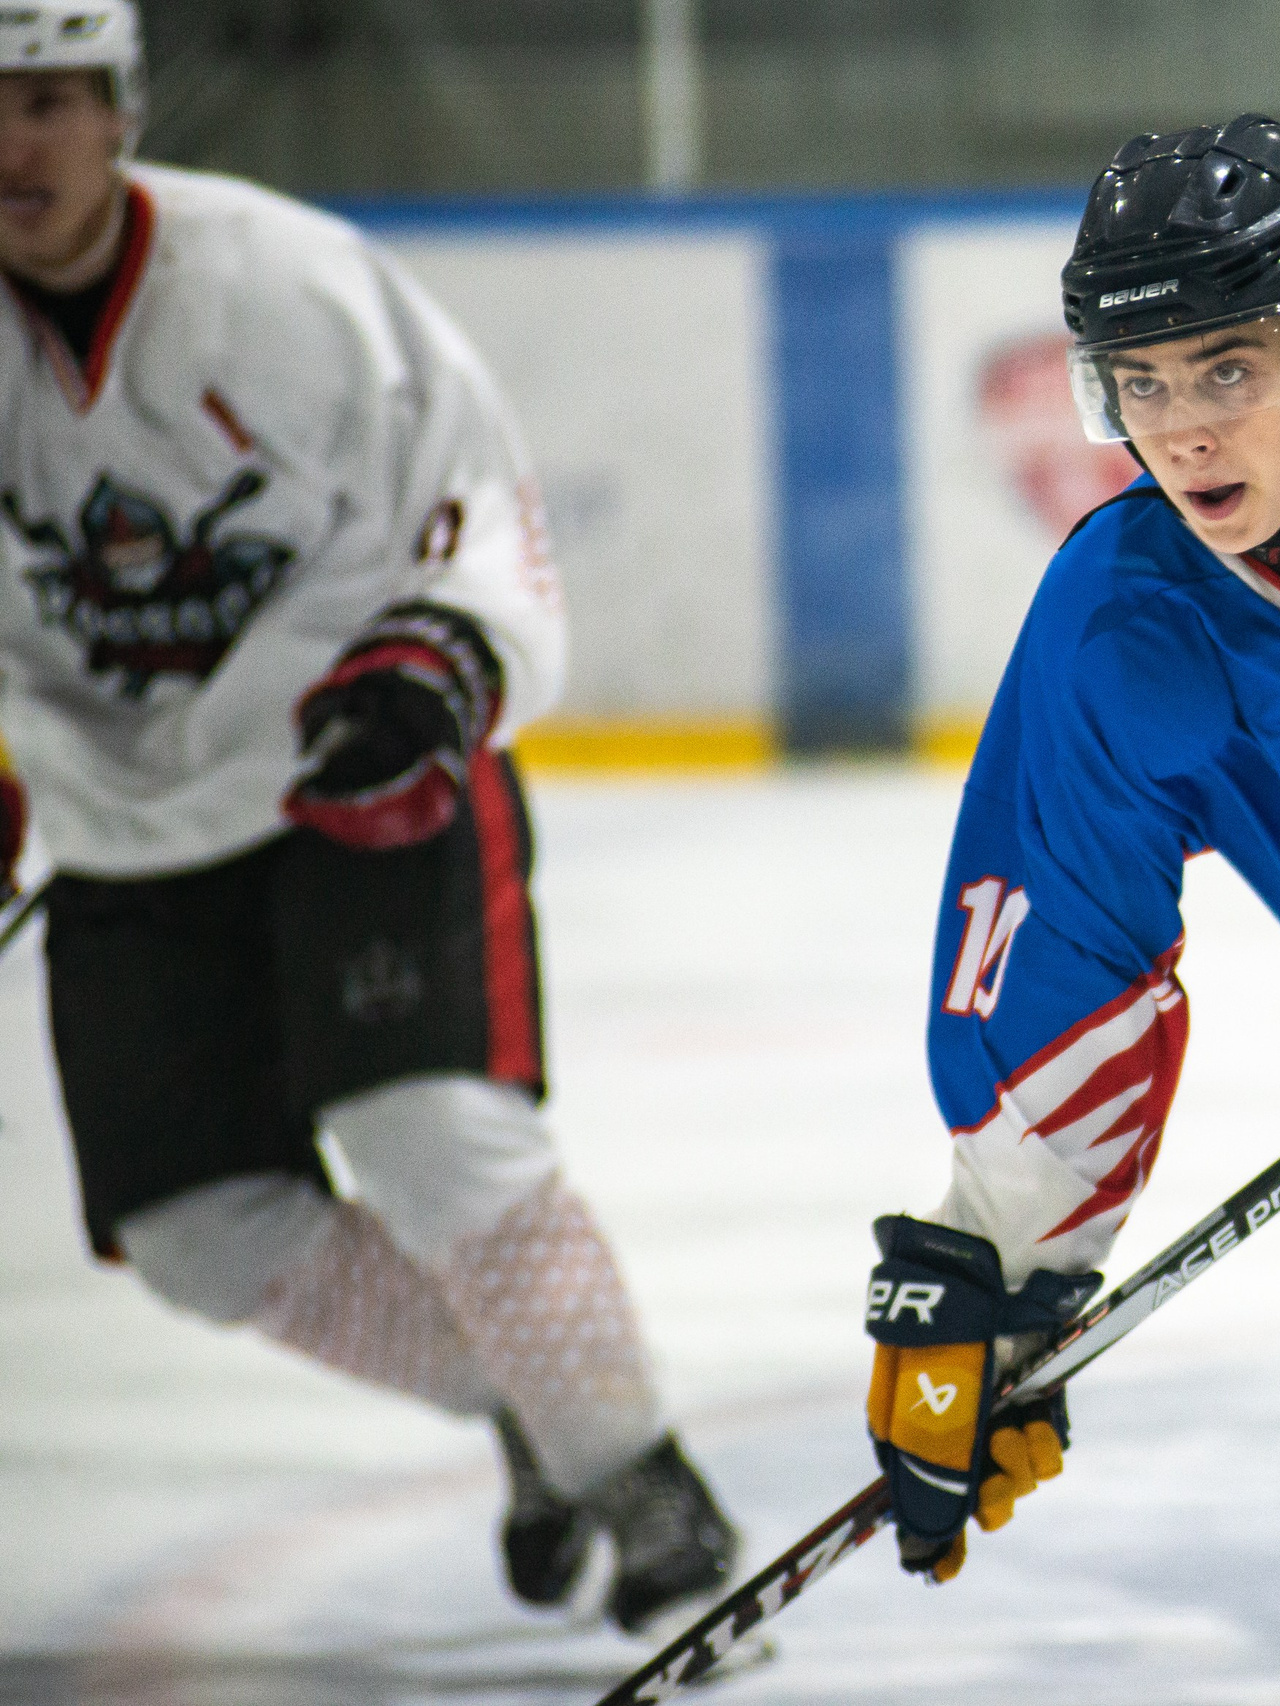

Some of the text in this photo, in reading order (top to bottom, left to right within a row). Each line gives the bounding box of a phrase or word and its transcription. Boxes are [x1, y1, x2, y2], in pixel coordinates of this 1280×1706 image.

[1099, 279, 1179, 309] BAUER
[941, 873, 1031, 1022] 10
[1152, 1219, 1240, 1311] ACE
